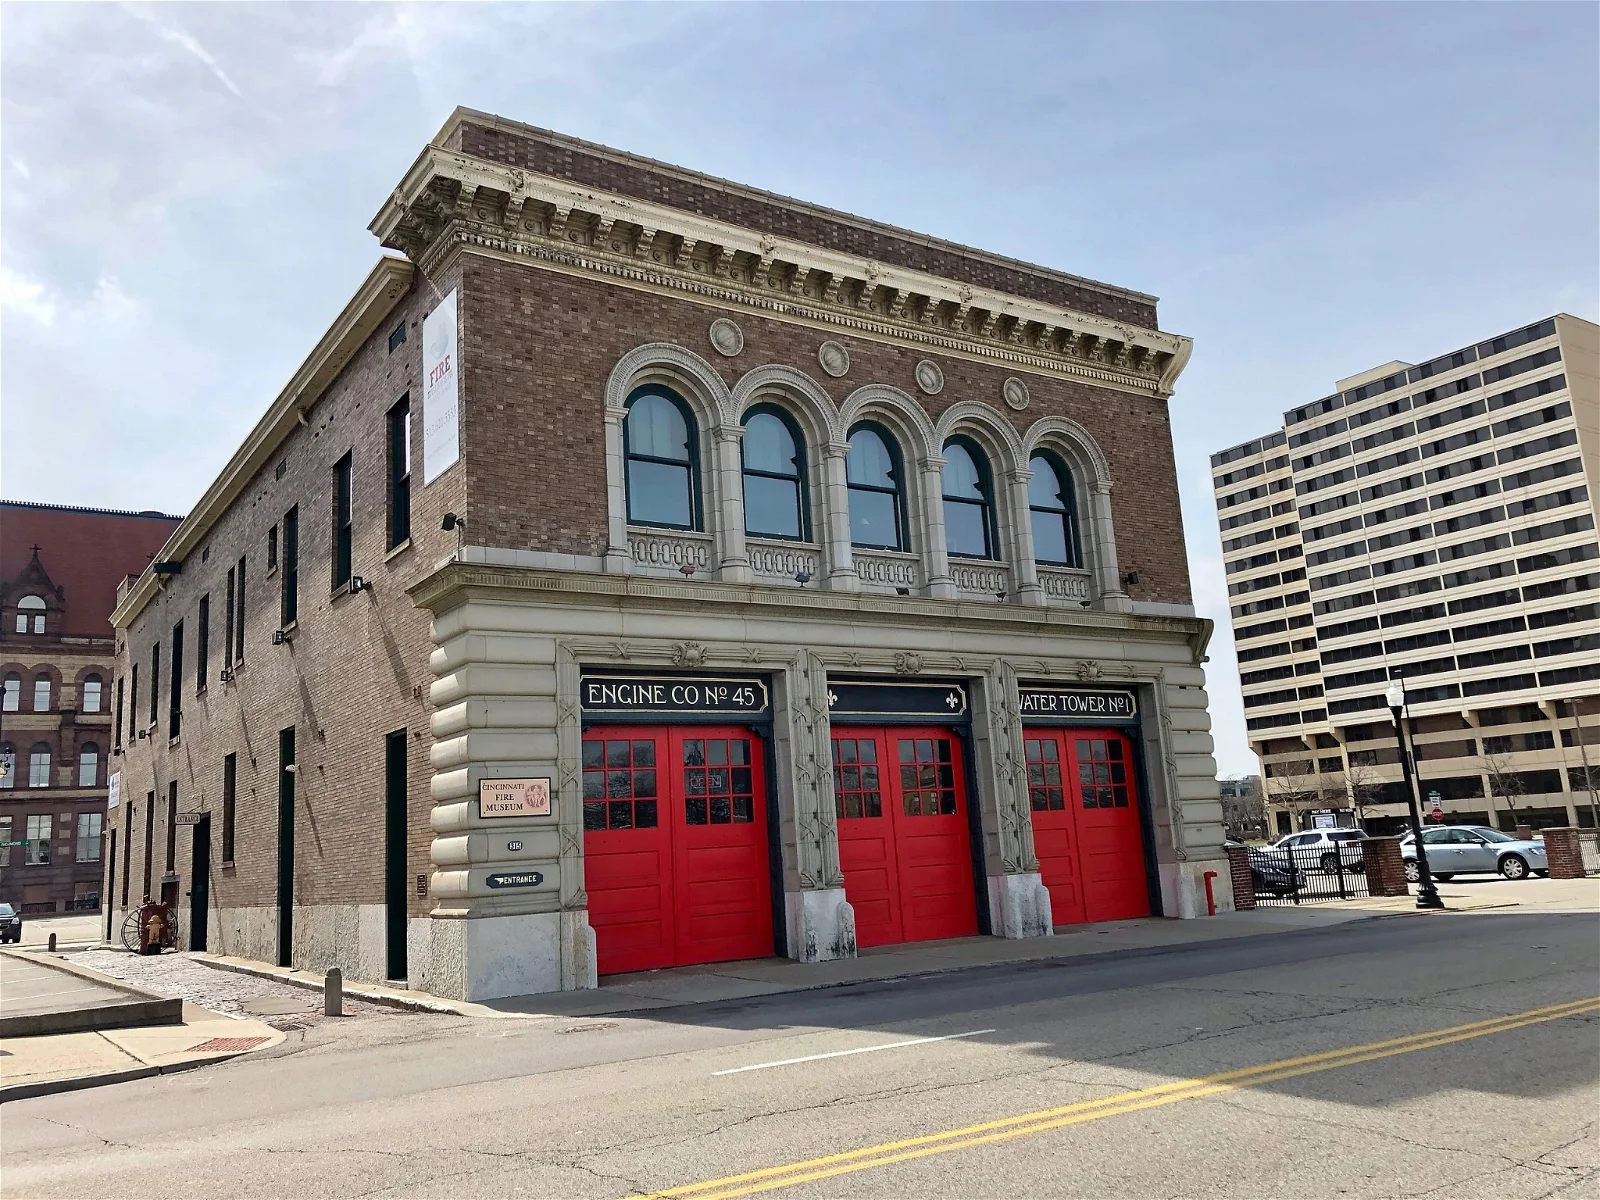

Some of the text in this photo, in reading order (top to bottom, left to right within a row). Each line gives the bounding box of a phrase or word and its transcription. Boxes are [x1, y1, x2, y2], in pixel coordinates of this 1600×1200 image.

[429, 354, 451, 388] FIRE
[588, 684, 667, 705] ENGINE
[671, 685, 699, 704] CO
[732, 687, 755, 706] 45
[1059, 695, 1106, 712] TOWER
[482, 783, 525, 791] CINCINNATI
[495, 793, 515, 801] FIRE
[486, 803, 524, 812] MUSEUM
[503, 875, 537, 884] ENTRANCE
